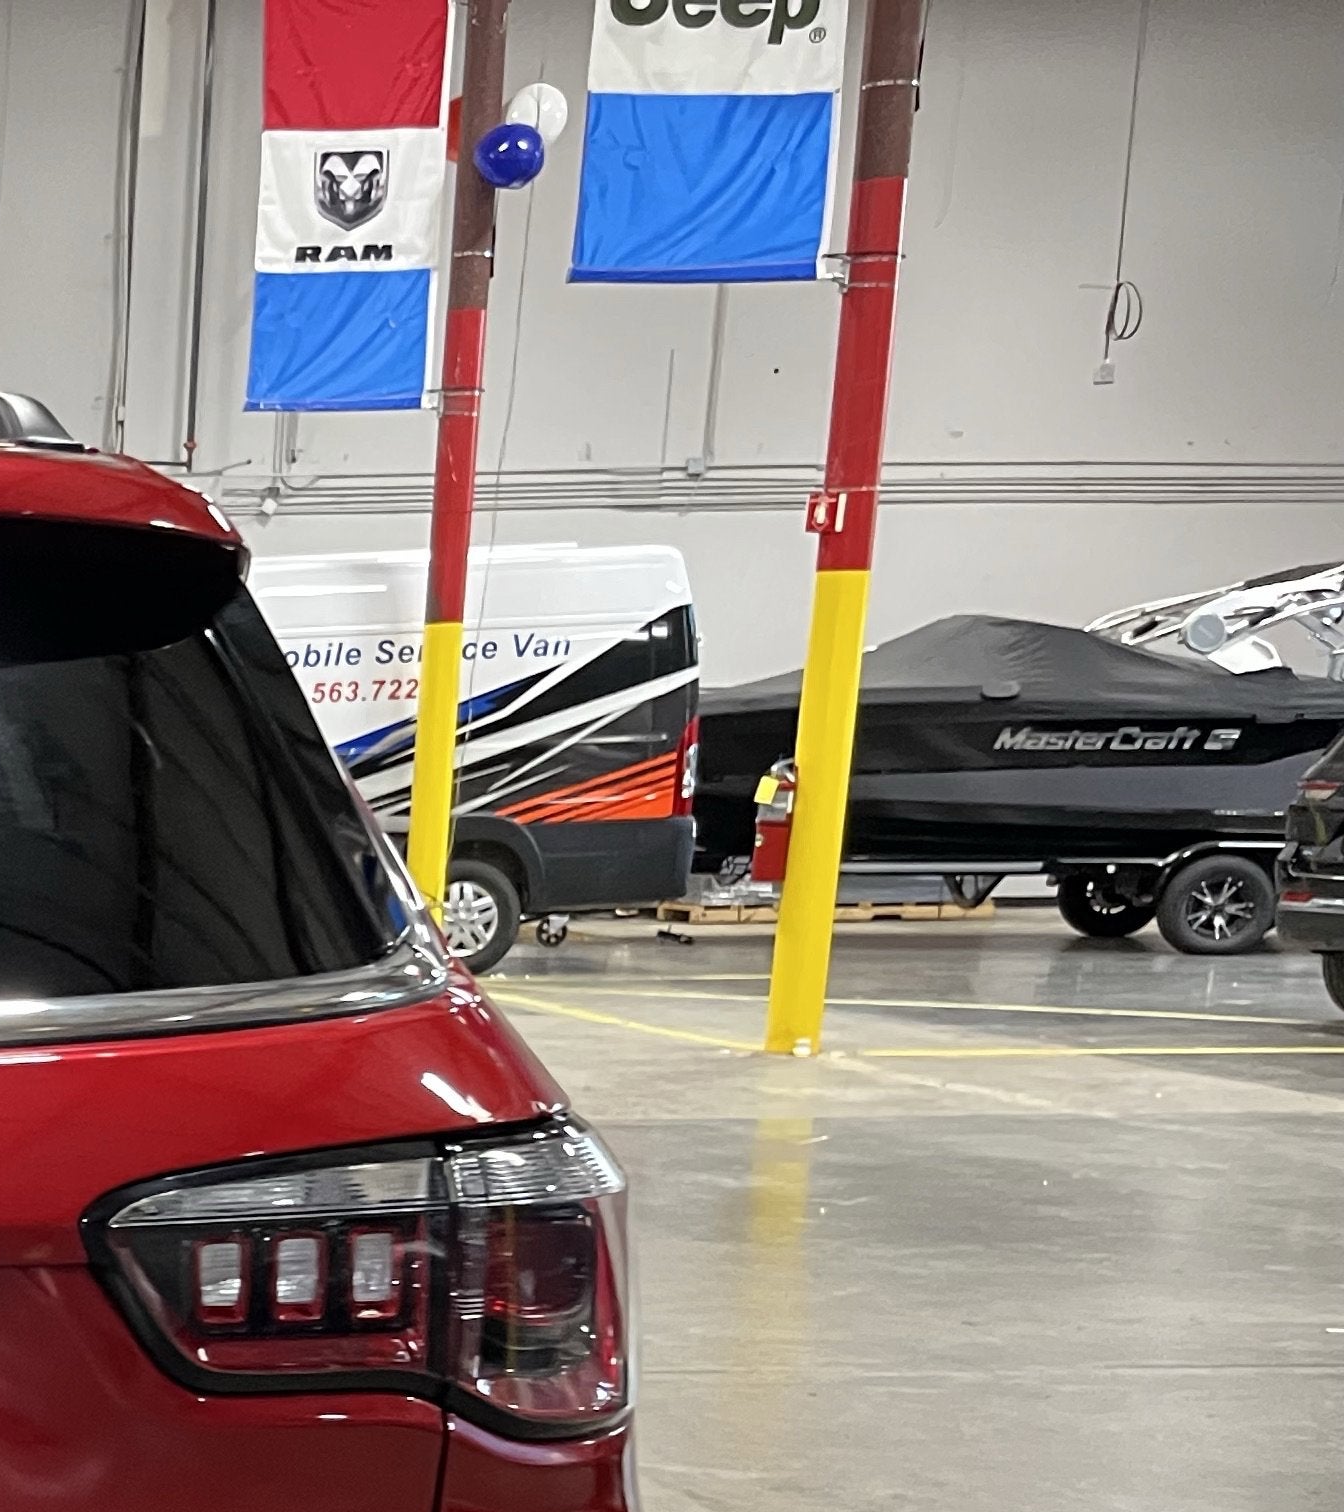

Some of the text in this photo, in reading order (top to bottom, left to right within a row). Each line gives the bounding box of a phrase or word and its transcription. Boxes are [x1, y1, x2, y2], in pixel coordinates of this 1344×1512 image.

[295, 244, 393, 263] RAM
[285, 643, 361, 668] obile
[513, 633, 570, 658] Van
[993, 726, 1201, 751] MasterCraft
